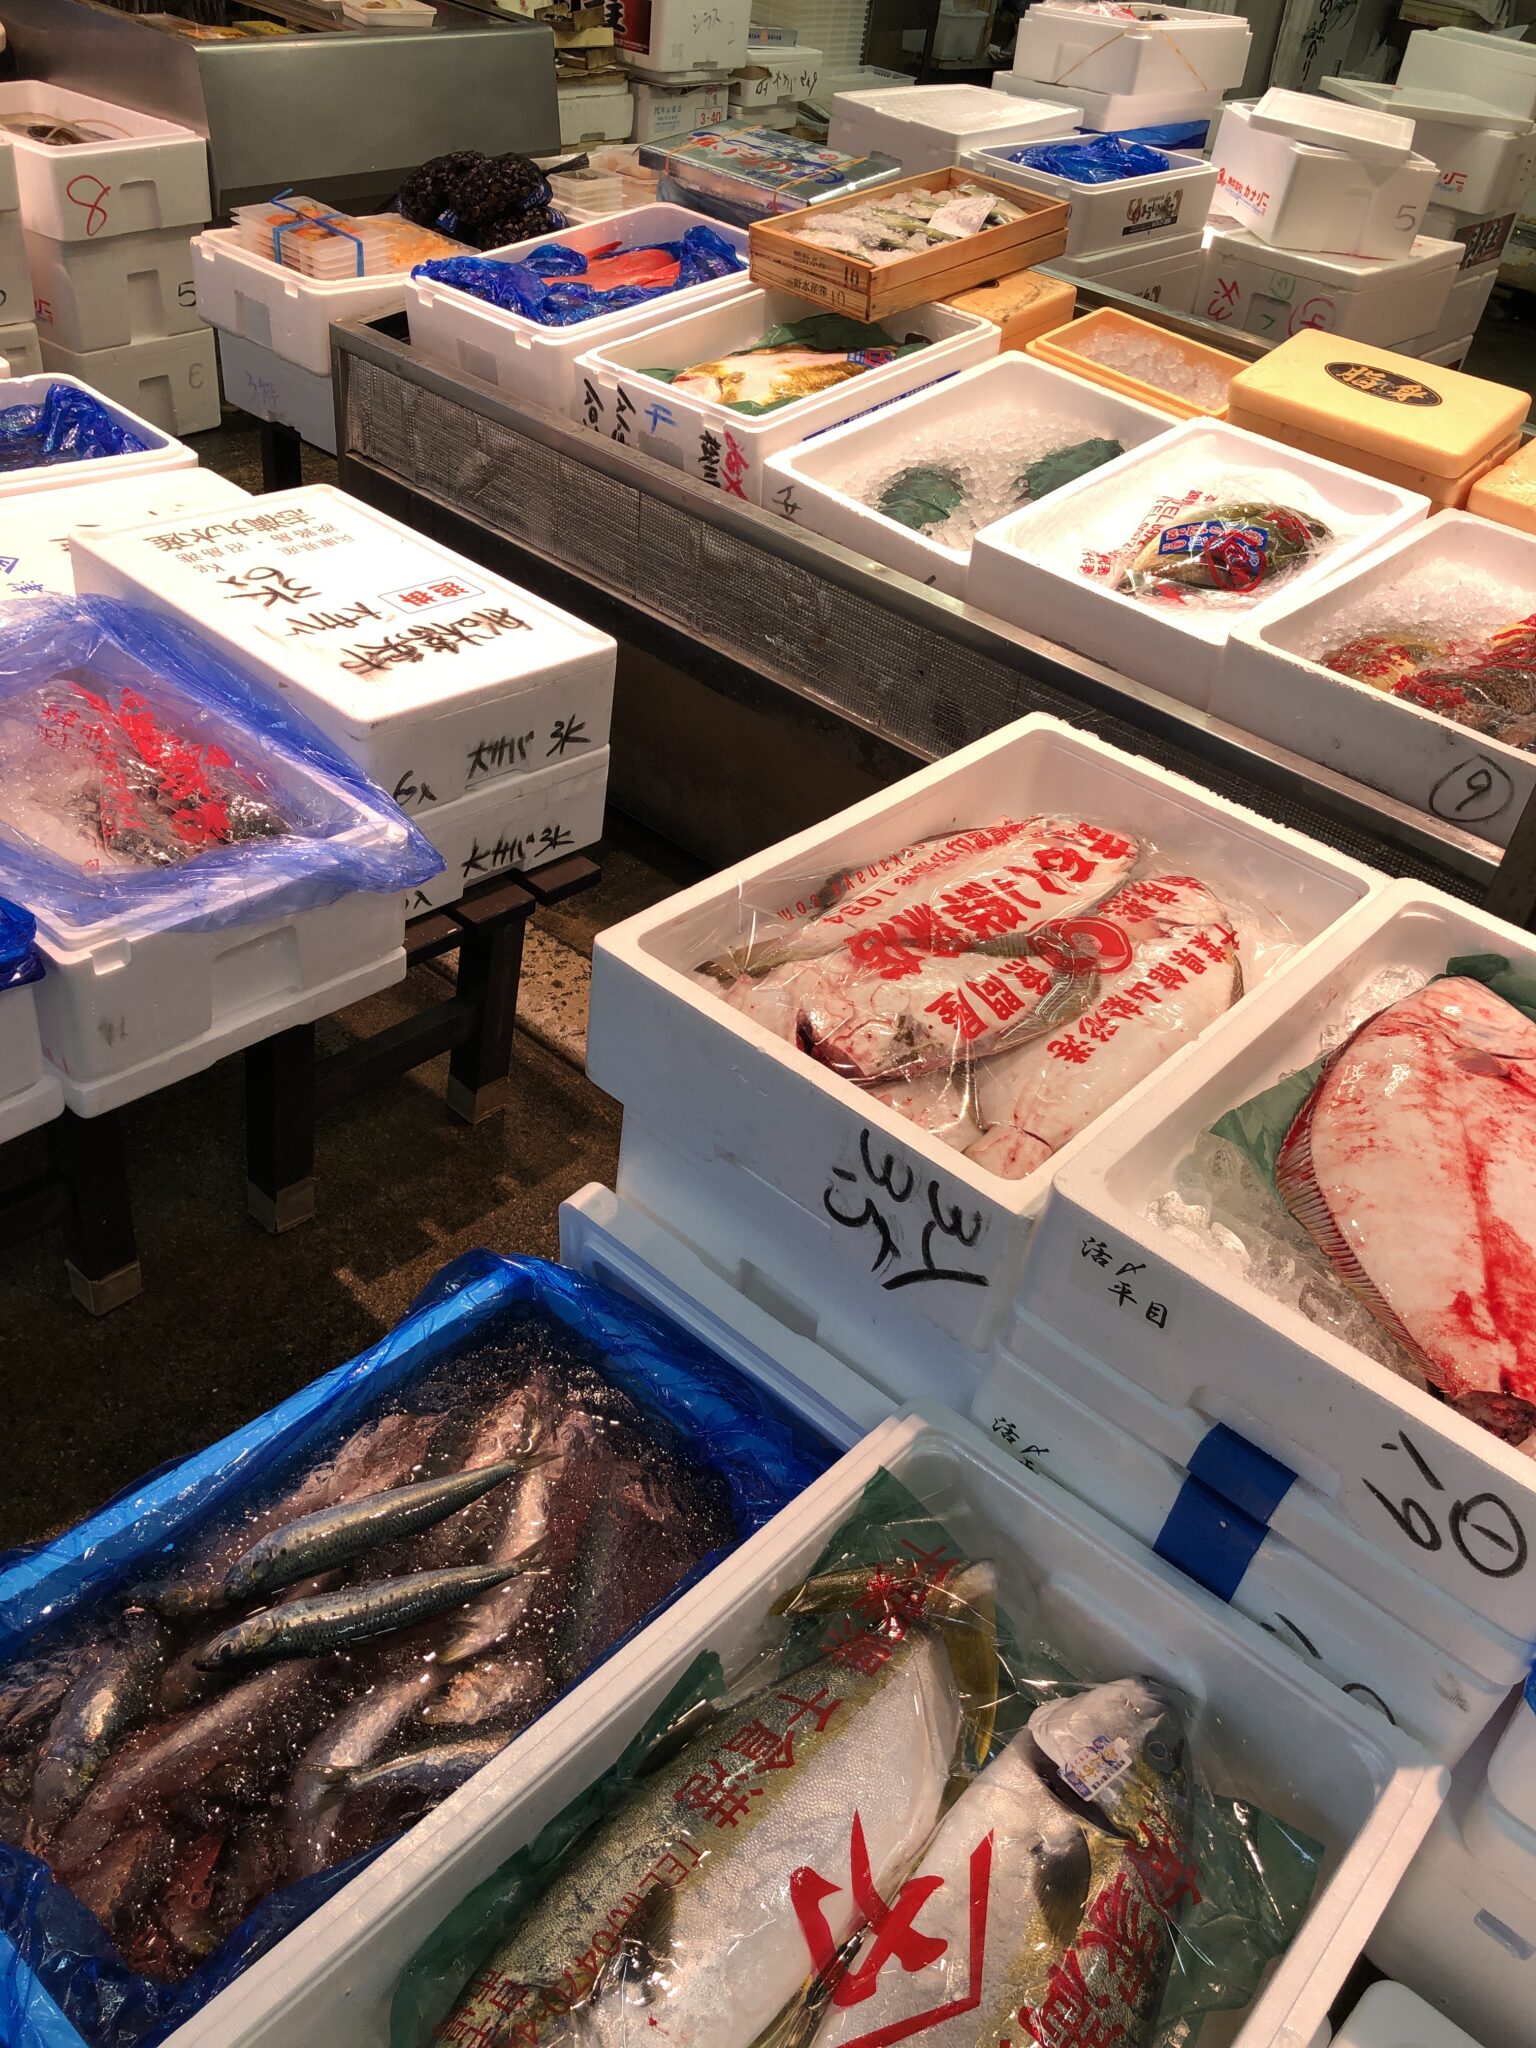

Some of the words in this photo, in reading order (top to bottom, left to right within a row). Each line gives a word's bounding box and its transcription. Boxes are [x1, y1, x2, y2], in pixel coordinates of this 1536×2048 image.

[700, 110, 723, 126] 3-40
[67, 175, 112, 236] 8
[1394, 205, 1417, 232] 5
[178, 280, 197, 307] 5
[188, 362, 206, 388] 6
[1108, 1281, 1170, 1330] 平目
[671, 1686, 843, 1830] 千倉港
